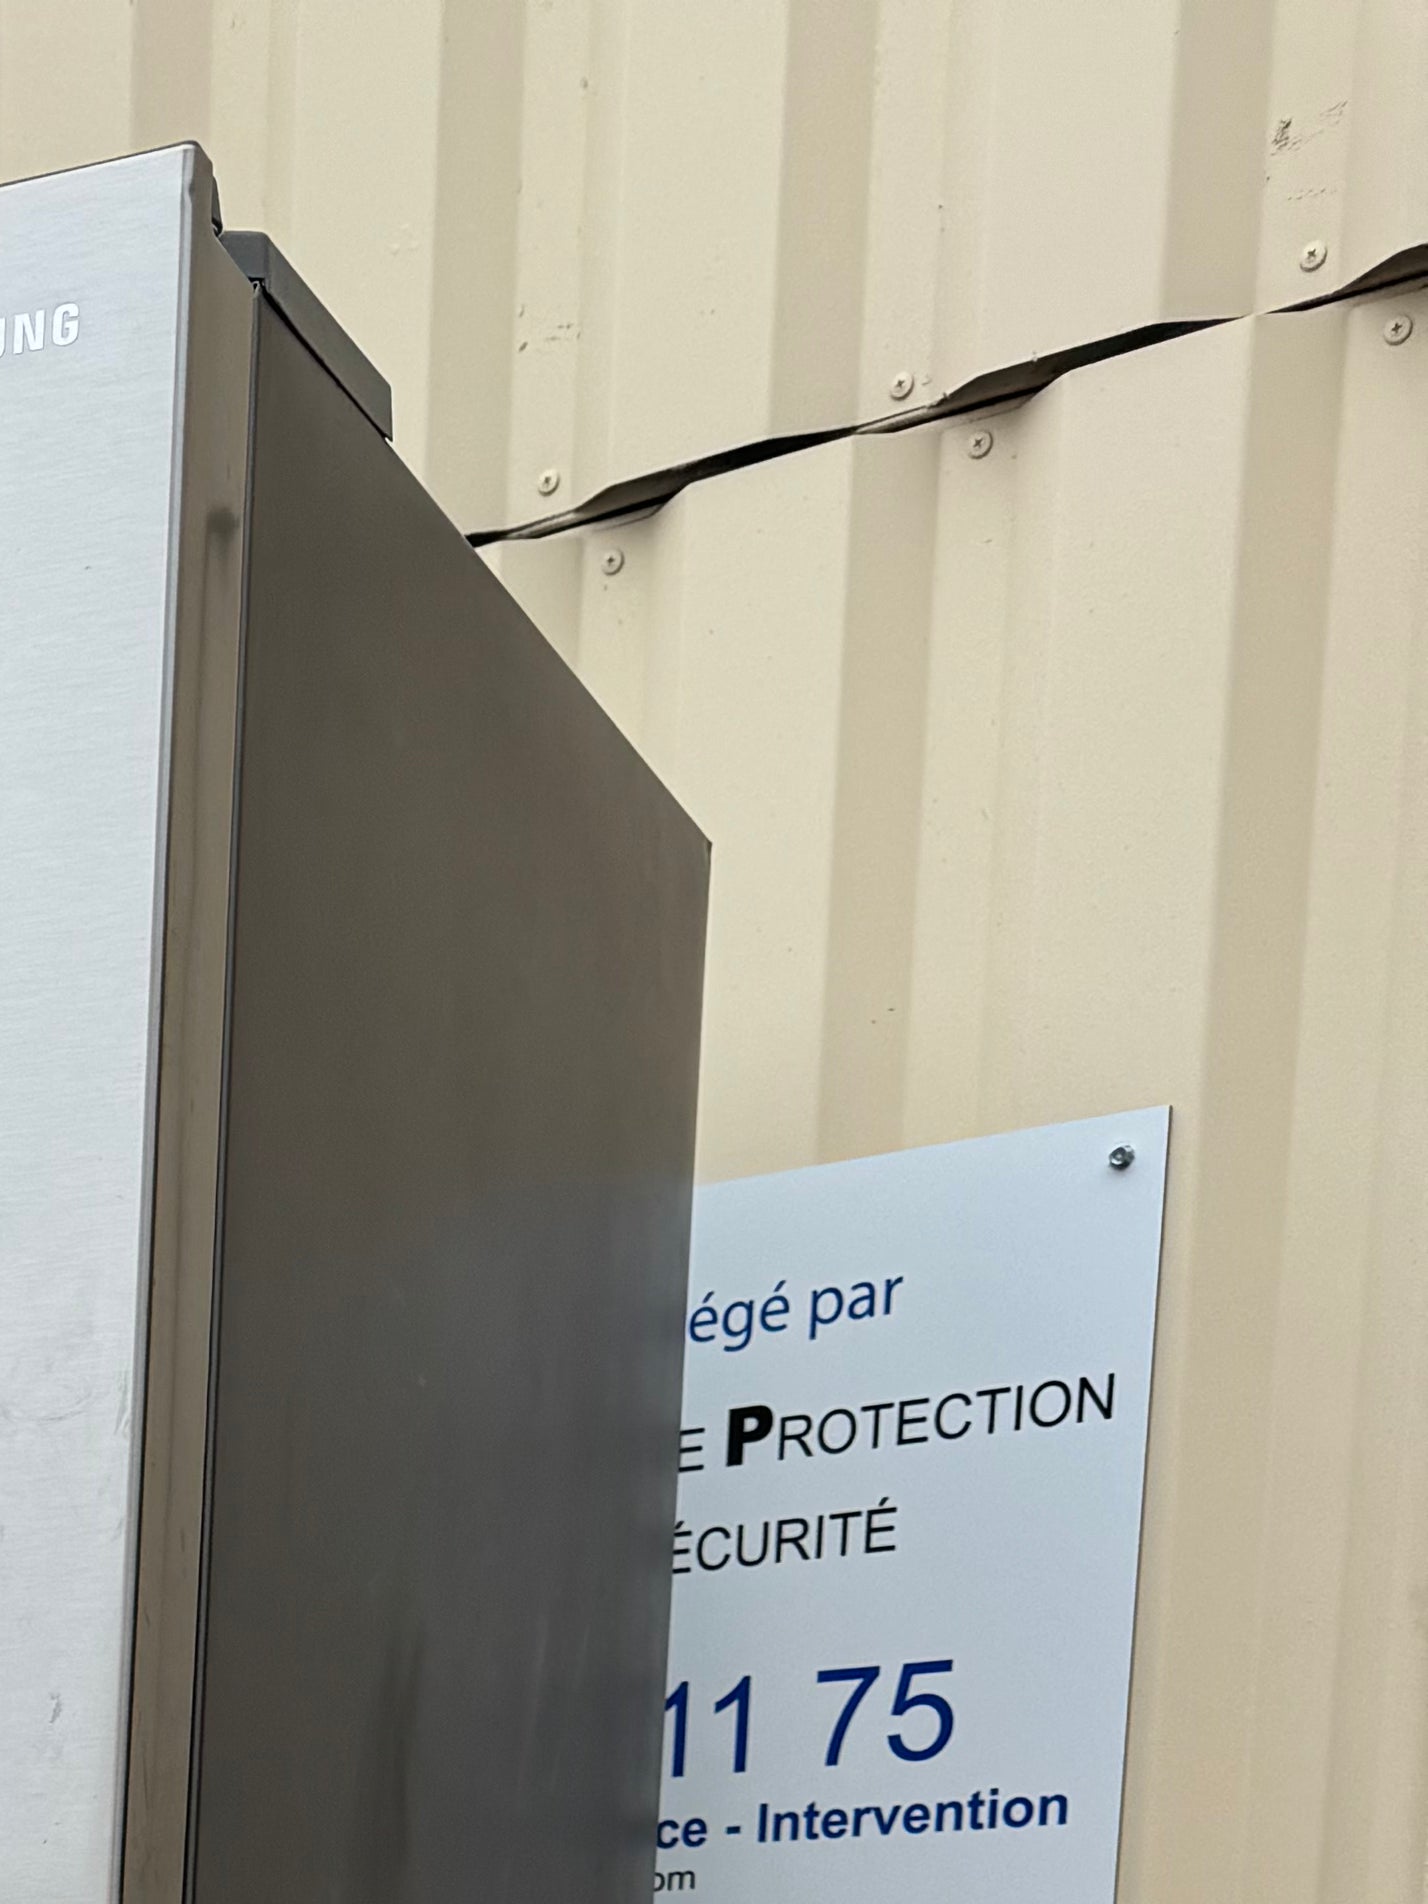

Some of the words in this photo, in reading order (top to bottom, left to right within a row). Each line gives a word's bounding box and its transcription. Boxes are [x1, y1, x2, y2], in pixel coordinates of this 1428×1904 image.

[809, 1276, 904, 1340] par
[726, 1372, 1116, 1467] PROTECTION
[664, 1675, 751, 1777] 11
[817, 1659, 955, 1766] 75
[758, 1789, 1069, 1842] Intervention
